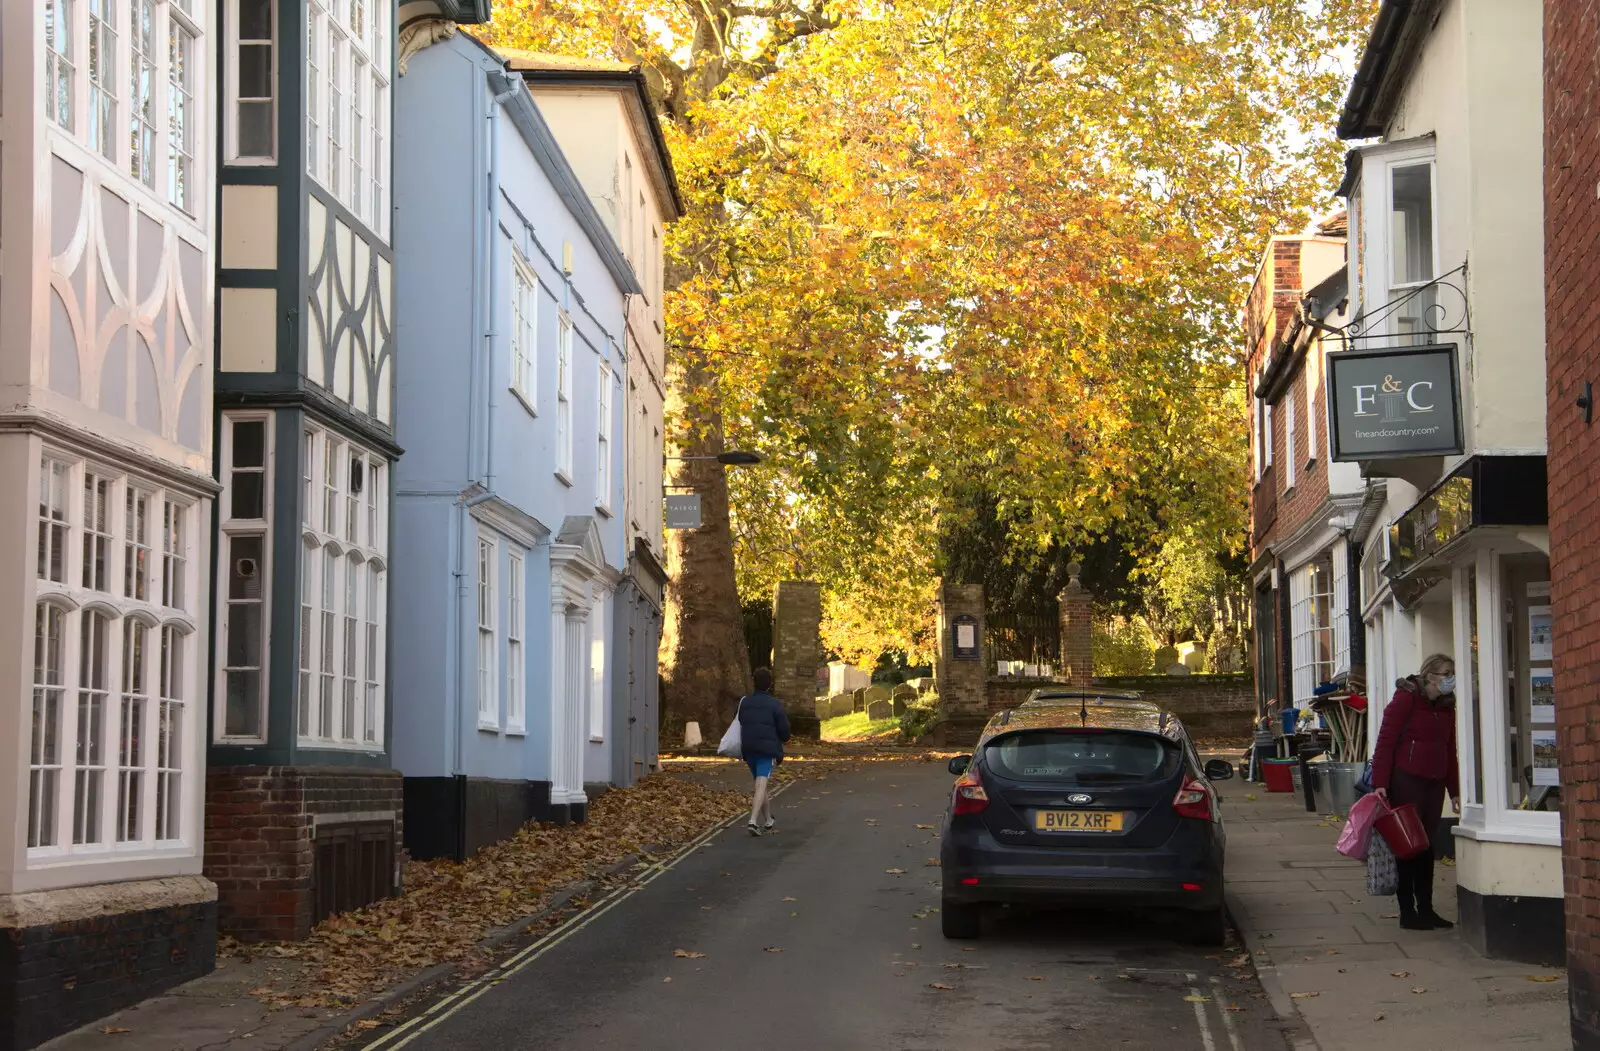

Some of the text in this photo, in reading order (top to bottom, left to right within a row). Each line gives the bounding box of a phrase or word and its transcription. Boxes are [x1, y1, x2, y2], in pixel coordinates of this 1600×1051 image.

[1352, 374, 1434, 414] F & C
[1045, 812, 1113, 828] BV12 XRF
